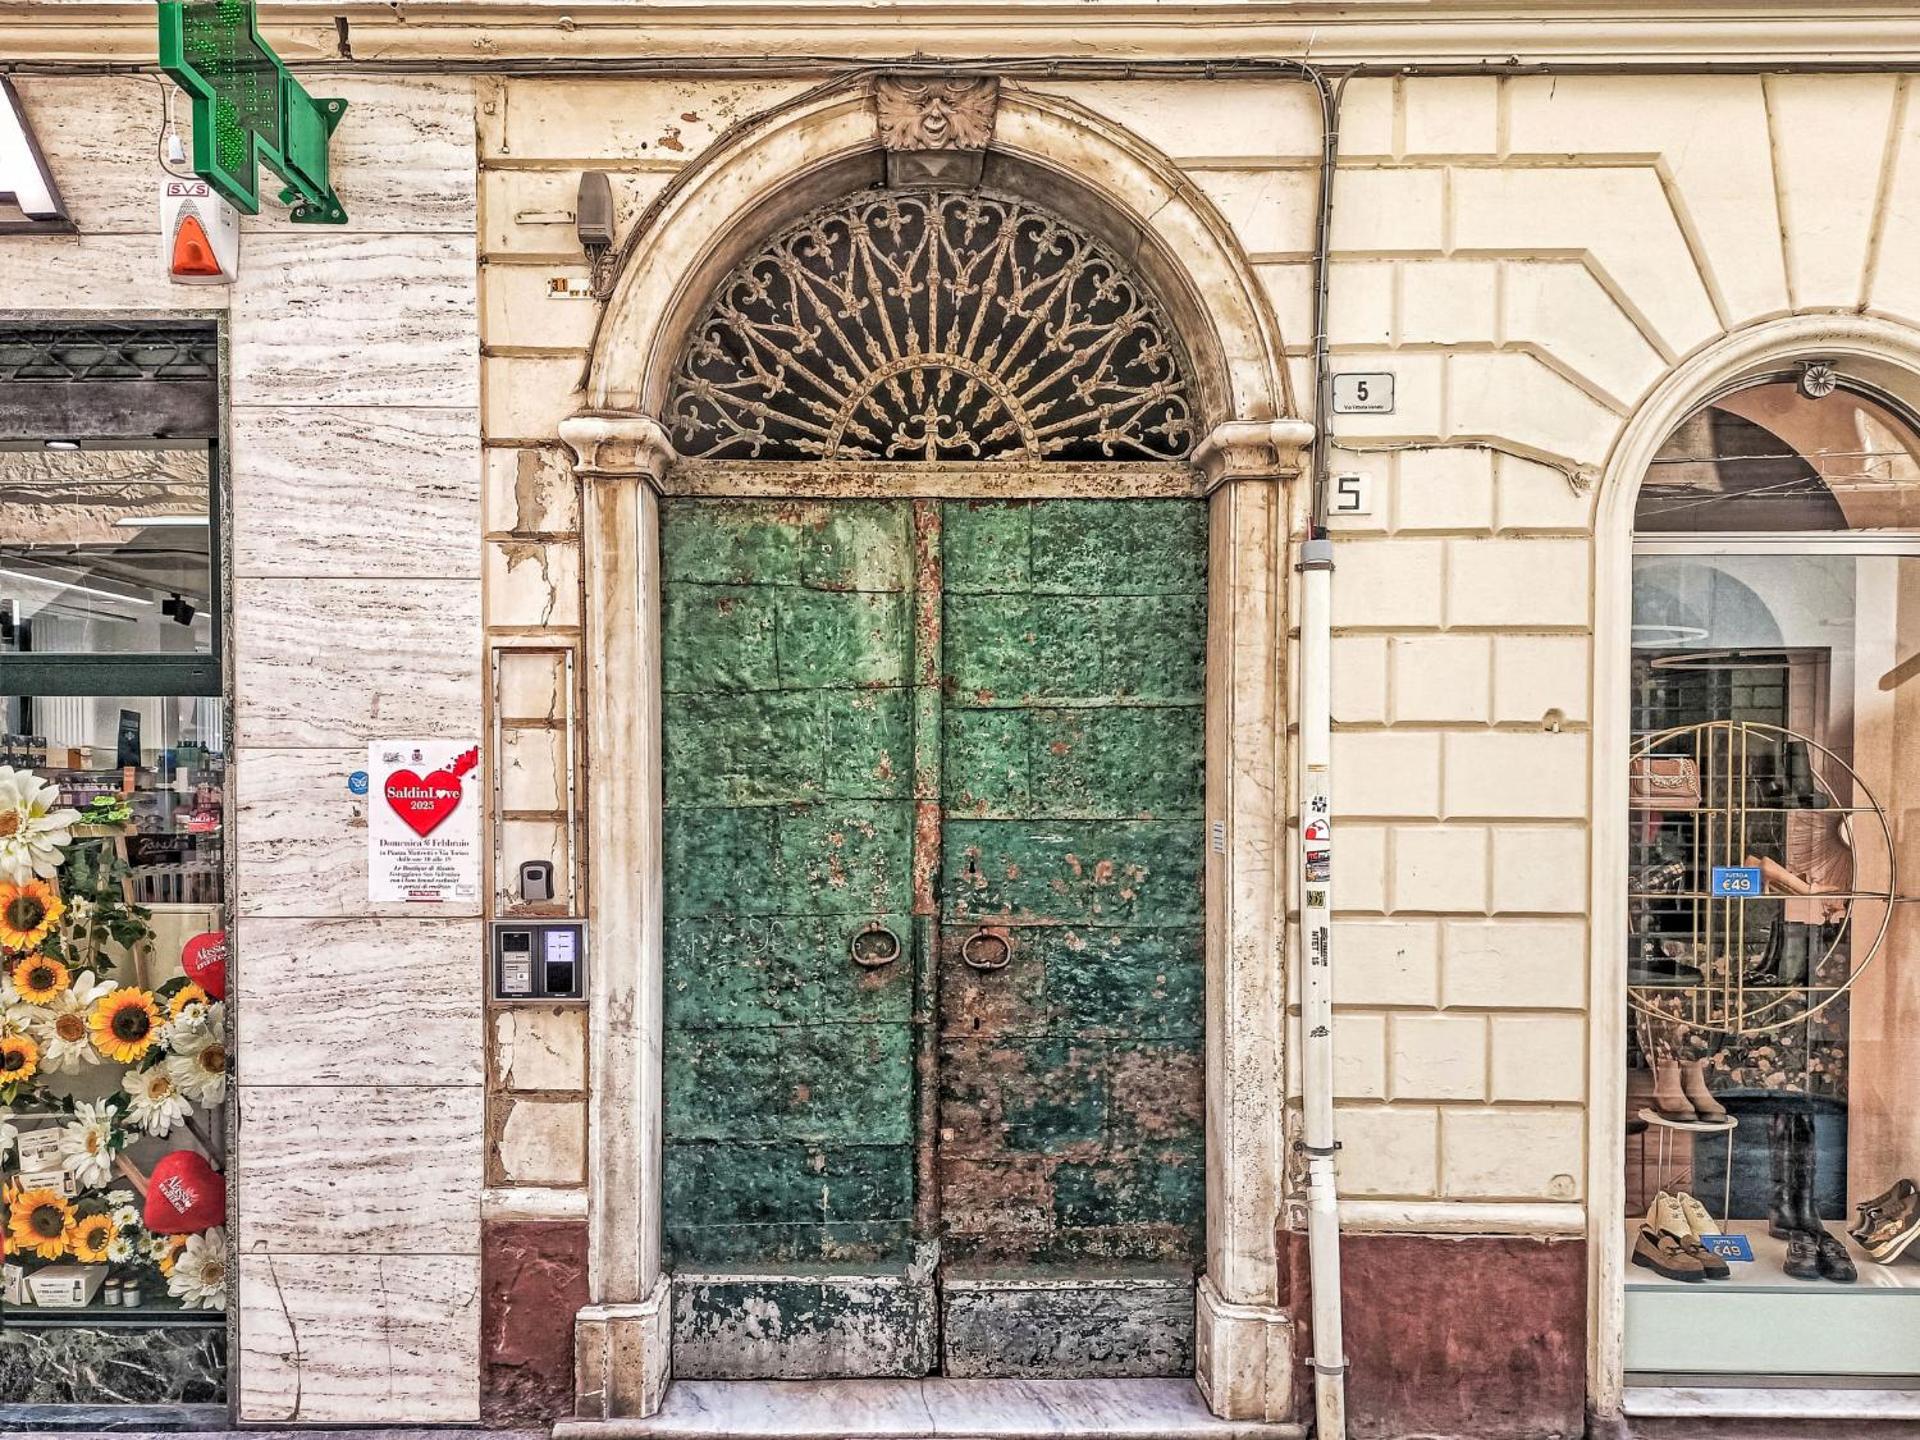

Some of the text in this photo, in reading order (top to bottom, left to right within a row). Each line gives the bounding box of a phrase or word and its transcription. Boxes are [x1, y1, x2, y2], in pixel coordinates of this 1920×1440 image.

[170, 185, 206, 195] SVS
[1357, 381, 1369, 401] 5
[1338, 477, 1360, 510] 5
[411, 801, 434, 810] 2025
[1722, 879, 1751, 890] €49
[1714, 1246, 1741, 1257] €49
